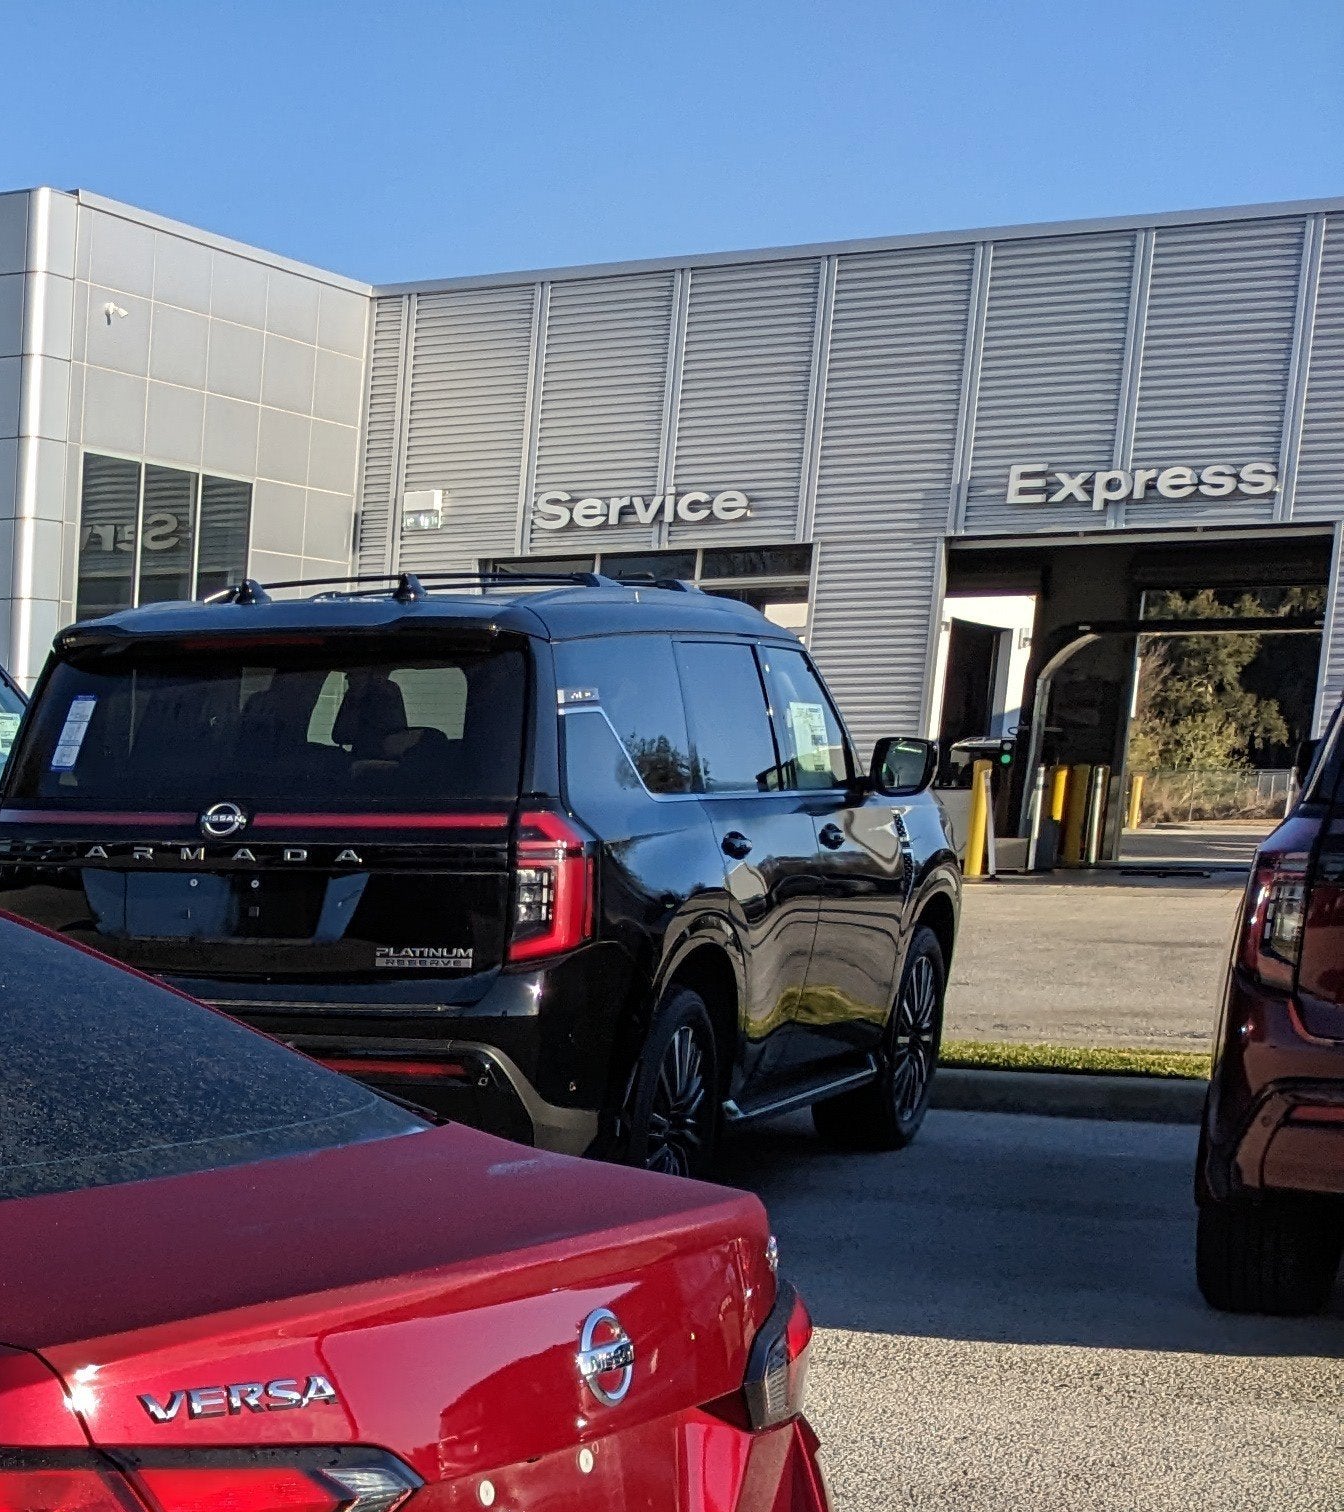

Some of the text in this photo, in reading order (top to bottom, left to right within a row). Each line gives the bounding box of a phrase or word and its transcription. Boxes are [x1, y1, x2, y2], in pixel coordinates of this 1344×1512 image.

[1006, 462, 1277, 511] Express
[533, 486, 749, 529] Service
[201, 813, 246, 823] NISSAN
[84, 845, 360, 862] ARMADA
[376, 947, 473, 957] PLATINUM
[136, 1375, 339, 1424] VERSA
